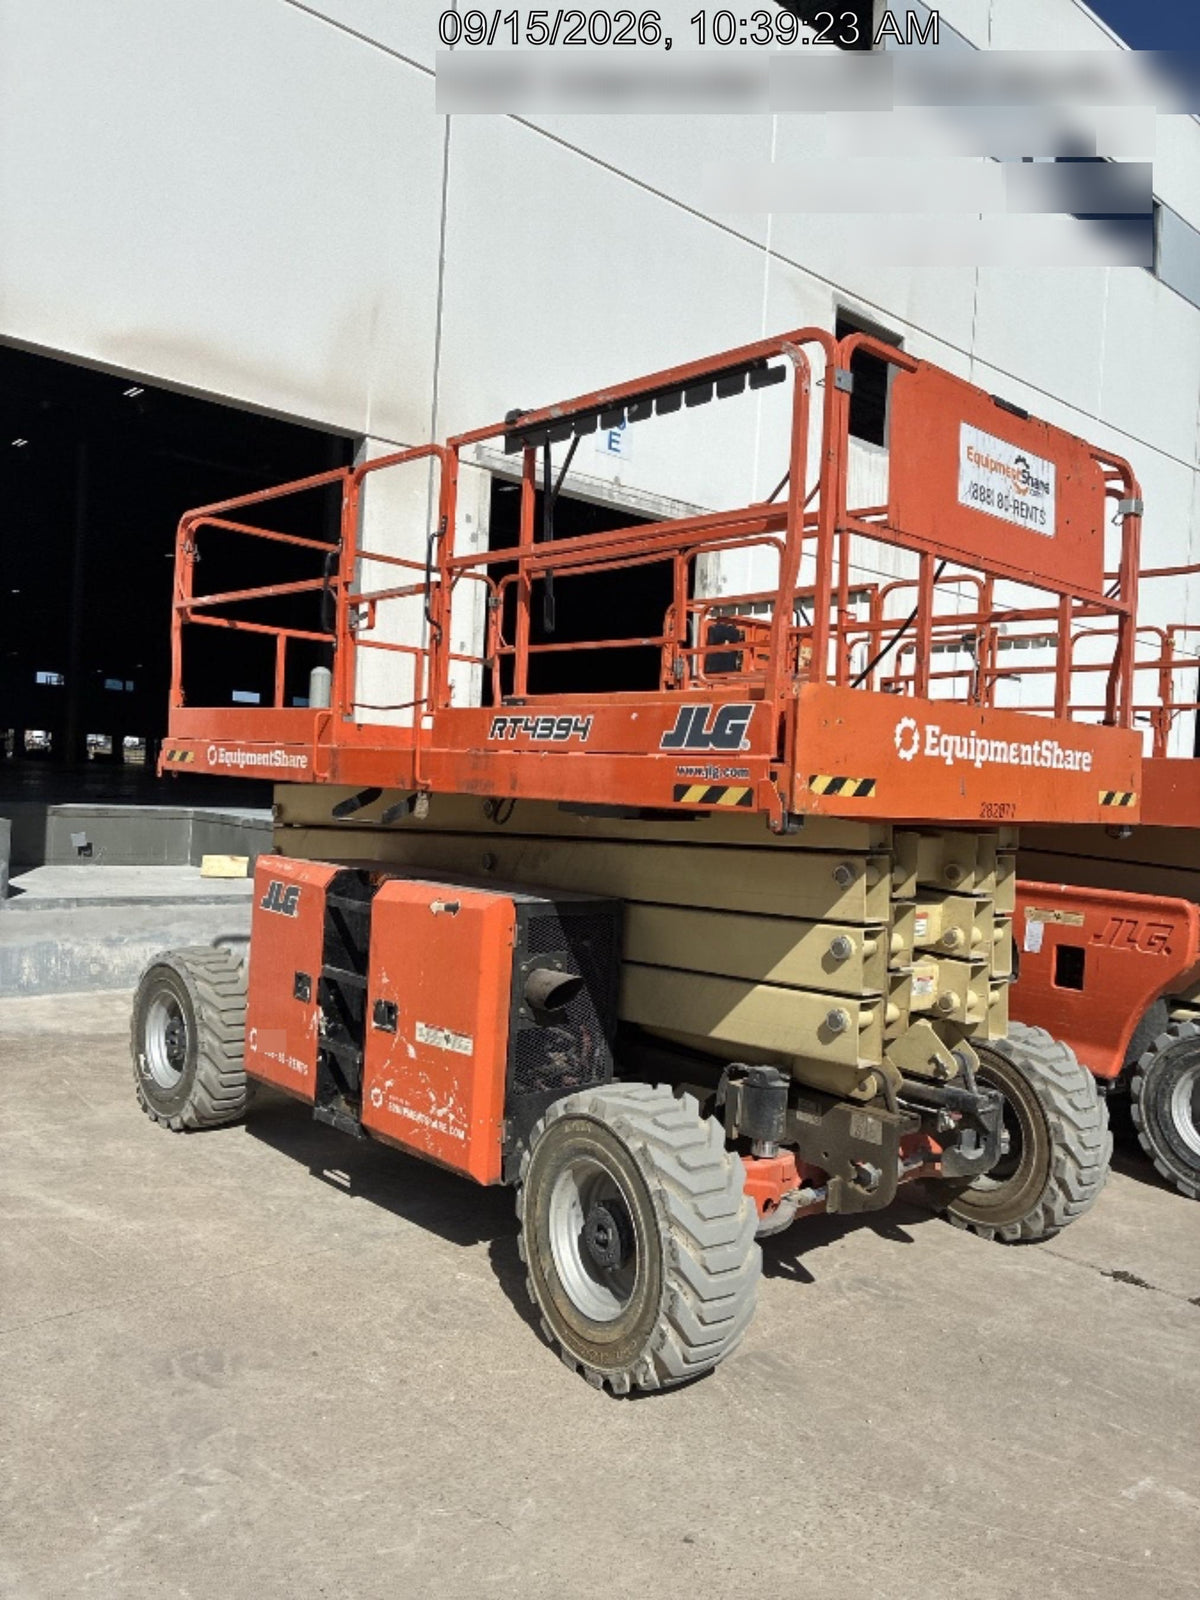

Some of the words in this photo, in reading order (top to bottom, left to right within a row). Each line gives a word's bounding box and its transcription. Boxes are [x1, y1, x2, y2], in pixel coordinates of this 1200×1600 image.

[487, 714, 594, 742] RT4394
[659, 703, 756, 750] JLG
[217, 747, 309, 769] EquipmentShare
[924, 724, 1092, 773] EquipmentShare
[675, 764, 751, 781] www.jlg.com
[259, 880, 302, 918] JLG
